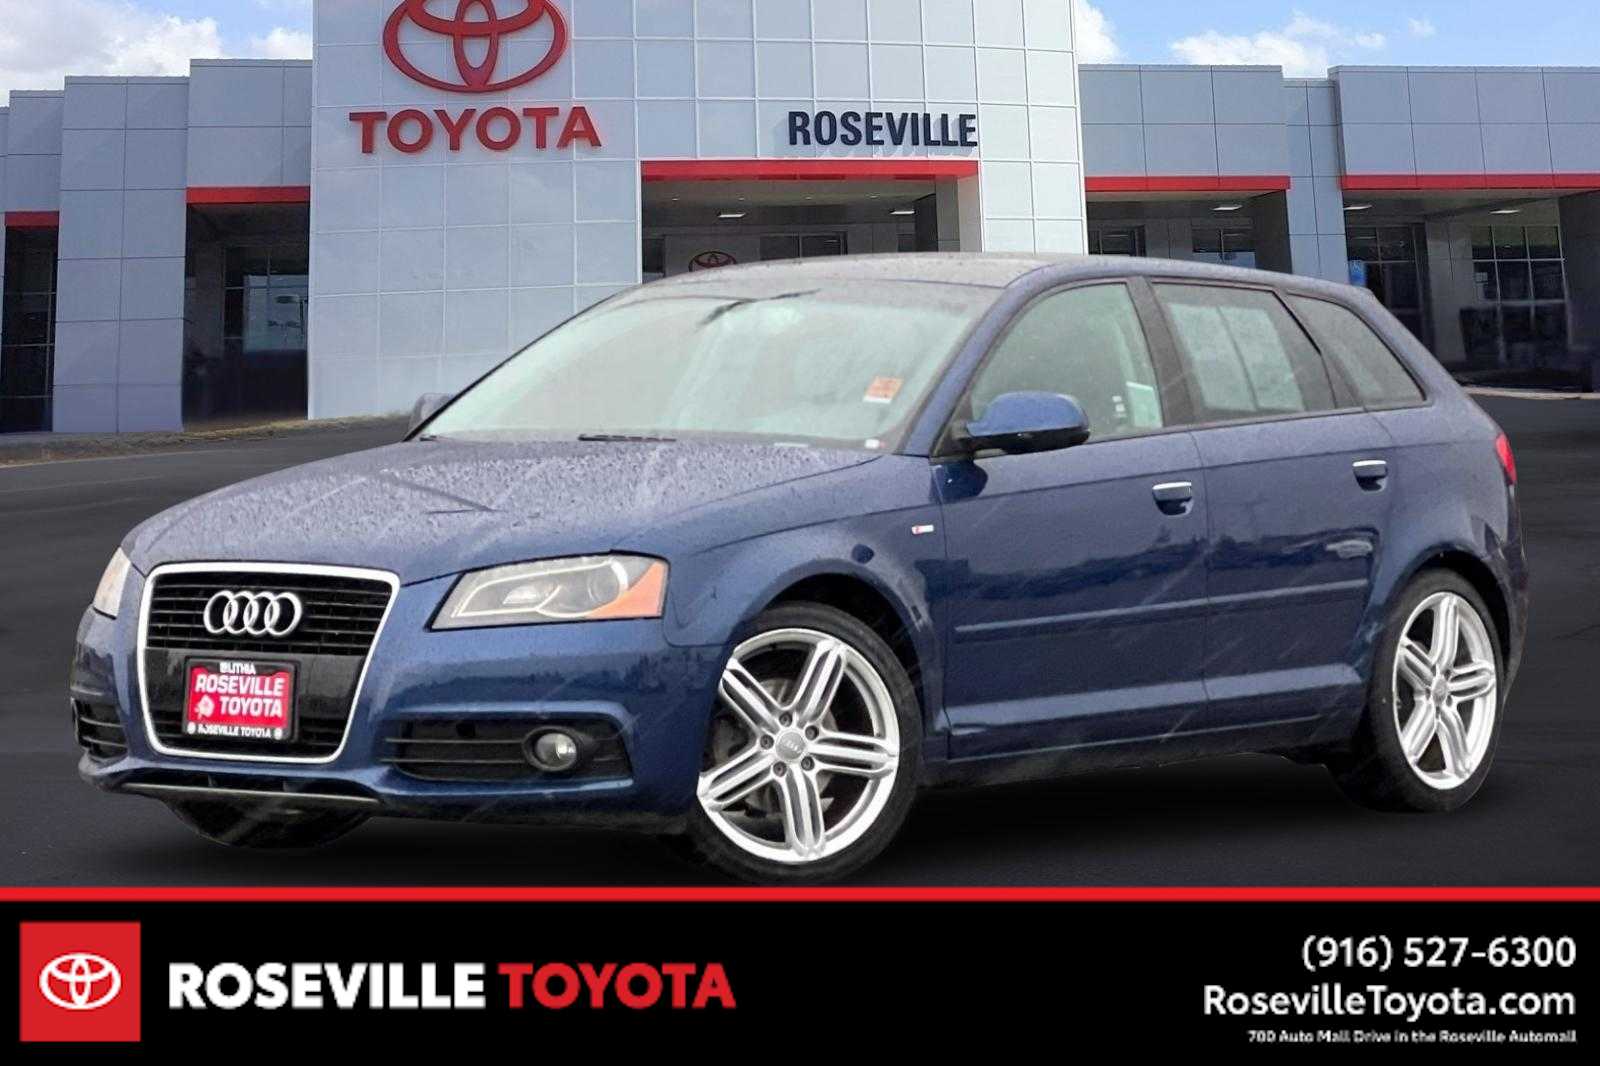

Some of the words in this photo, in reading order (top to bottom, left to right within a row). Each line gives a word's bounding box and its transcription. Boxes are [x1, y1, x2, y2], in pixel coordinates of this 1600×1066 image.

[349, 106, 602, 154] TOYOTA
[788, 110, 979, 147] ROSEVILLE
[195, 673, 285, 697] ROSEVILLE
[219, 695, 283, 718] TOYOTA
[198, 723, 239, 737] ROSEVILLE
[240, 726, 271, 739] TOYOTA
